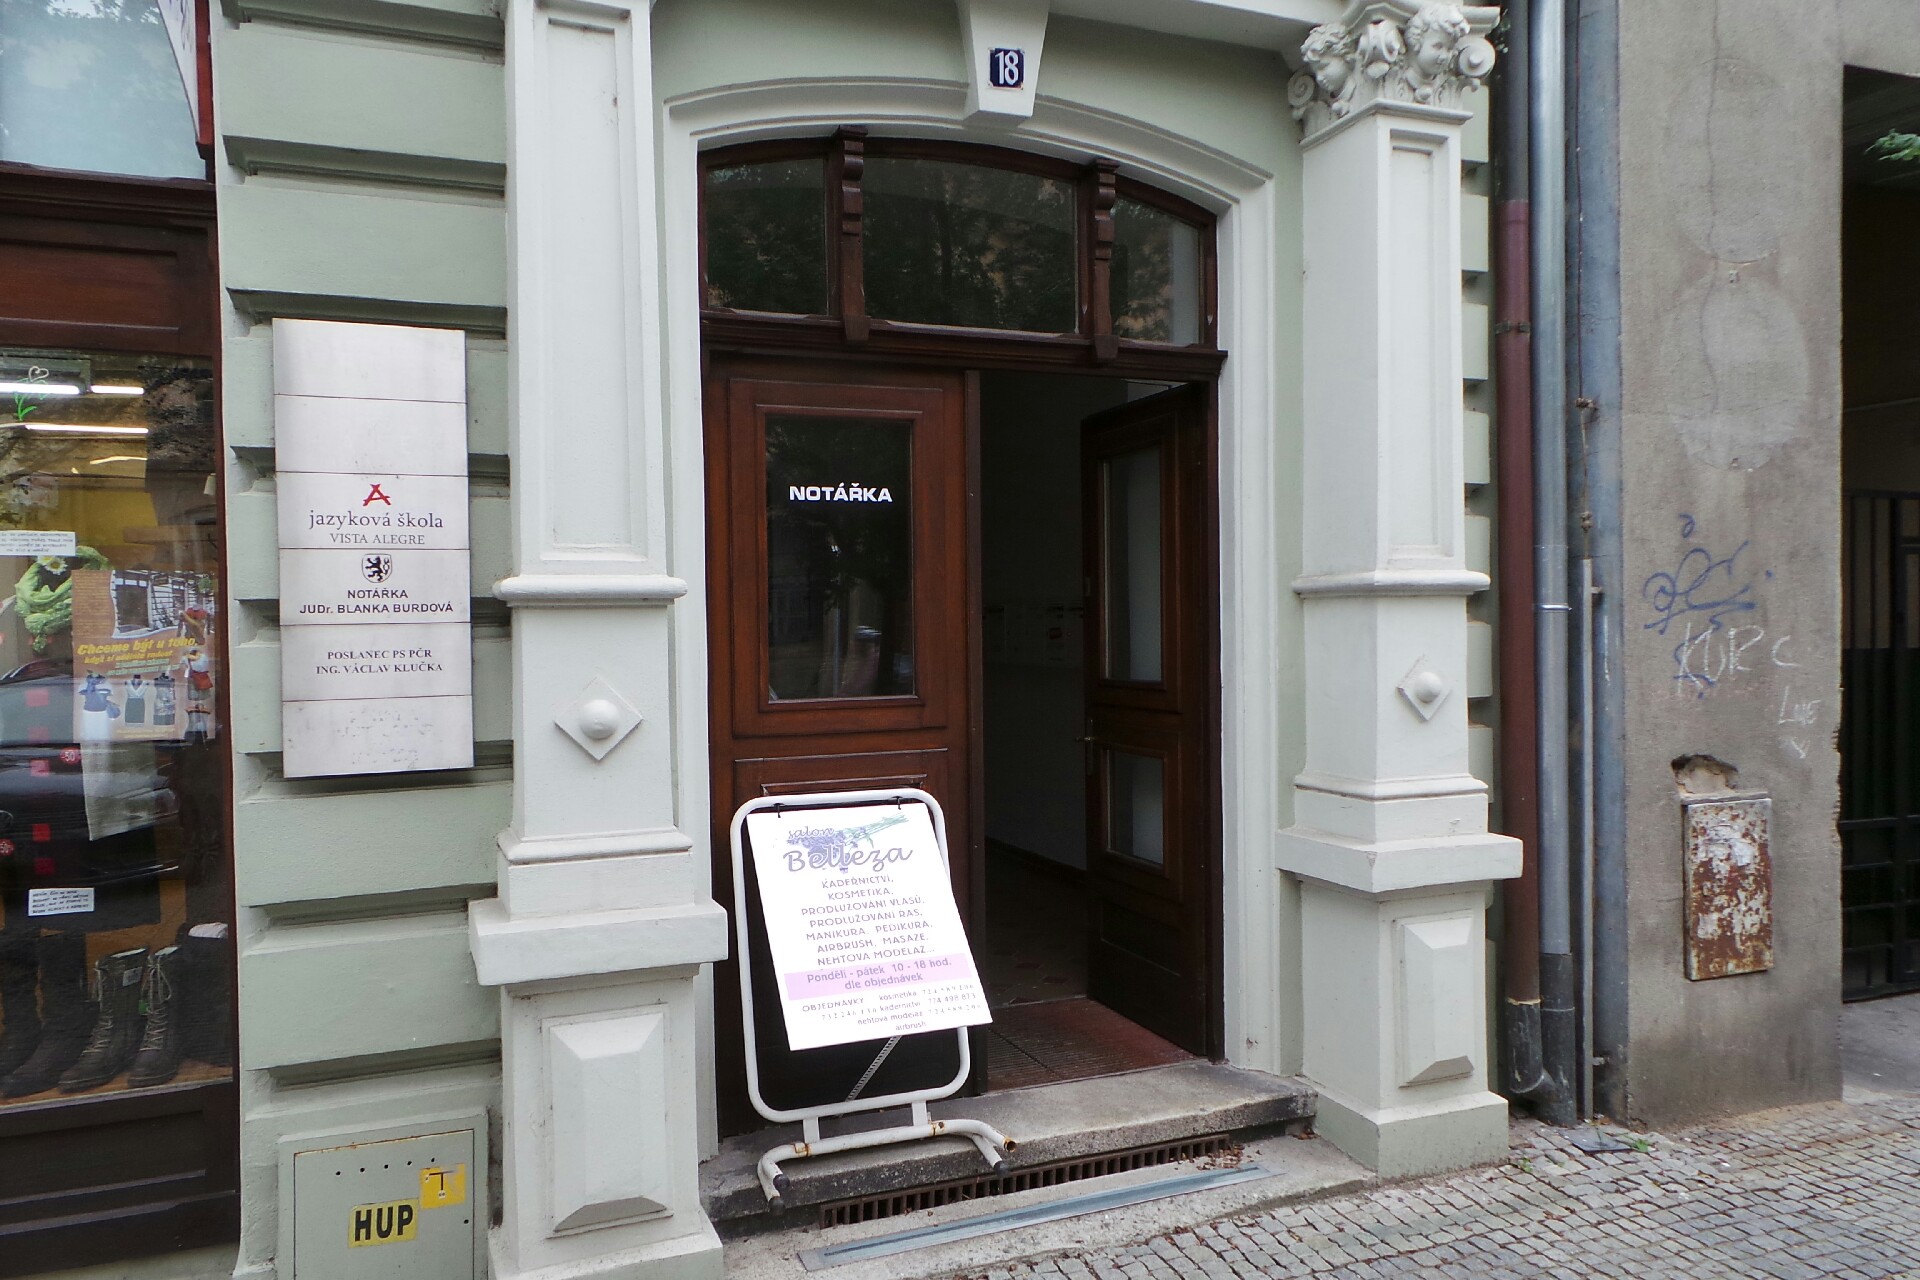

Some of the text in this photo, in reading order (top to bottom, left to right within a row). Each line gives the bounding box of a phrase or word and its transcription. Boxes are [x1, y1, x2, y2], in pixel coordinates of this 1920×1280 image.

[995, 51, 1018, 85] 18
[790, 482, 892, 502] NOTÁŘKA
[309, 510, 444, 530] jazyková škola
[330, 533, 425, 545] VISTA ALEGRE
[347, 588, 408, 599] NOTÁŘKA
[300, 601, 453, 614] JUDr. BLANKA BURDOVÁ
[78, 643, 130, 656] Chceme
[134, 638, 155, 654] být
[328, 648, 432, 660] POSLANEC PS PČR
[316, 661, 442, 674] ING. VÁCLAV KLUČKA
[788, 826, 836, 840] salon
[783, 841, 913, 872] Belleza
[807, 969, 847, 984] Pondělí
[857, 962, 886, 978] pátek
[892, 963, 904, 973] 10
[914, 960, 926, 970] 18
[930, 957, 952, 967] hod.
[844, 972, 924, 990] dle objednávek
[878, 990, 917, 1001] kosmetika
[354, 1204, 414, 1242] HUP
